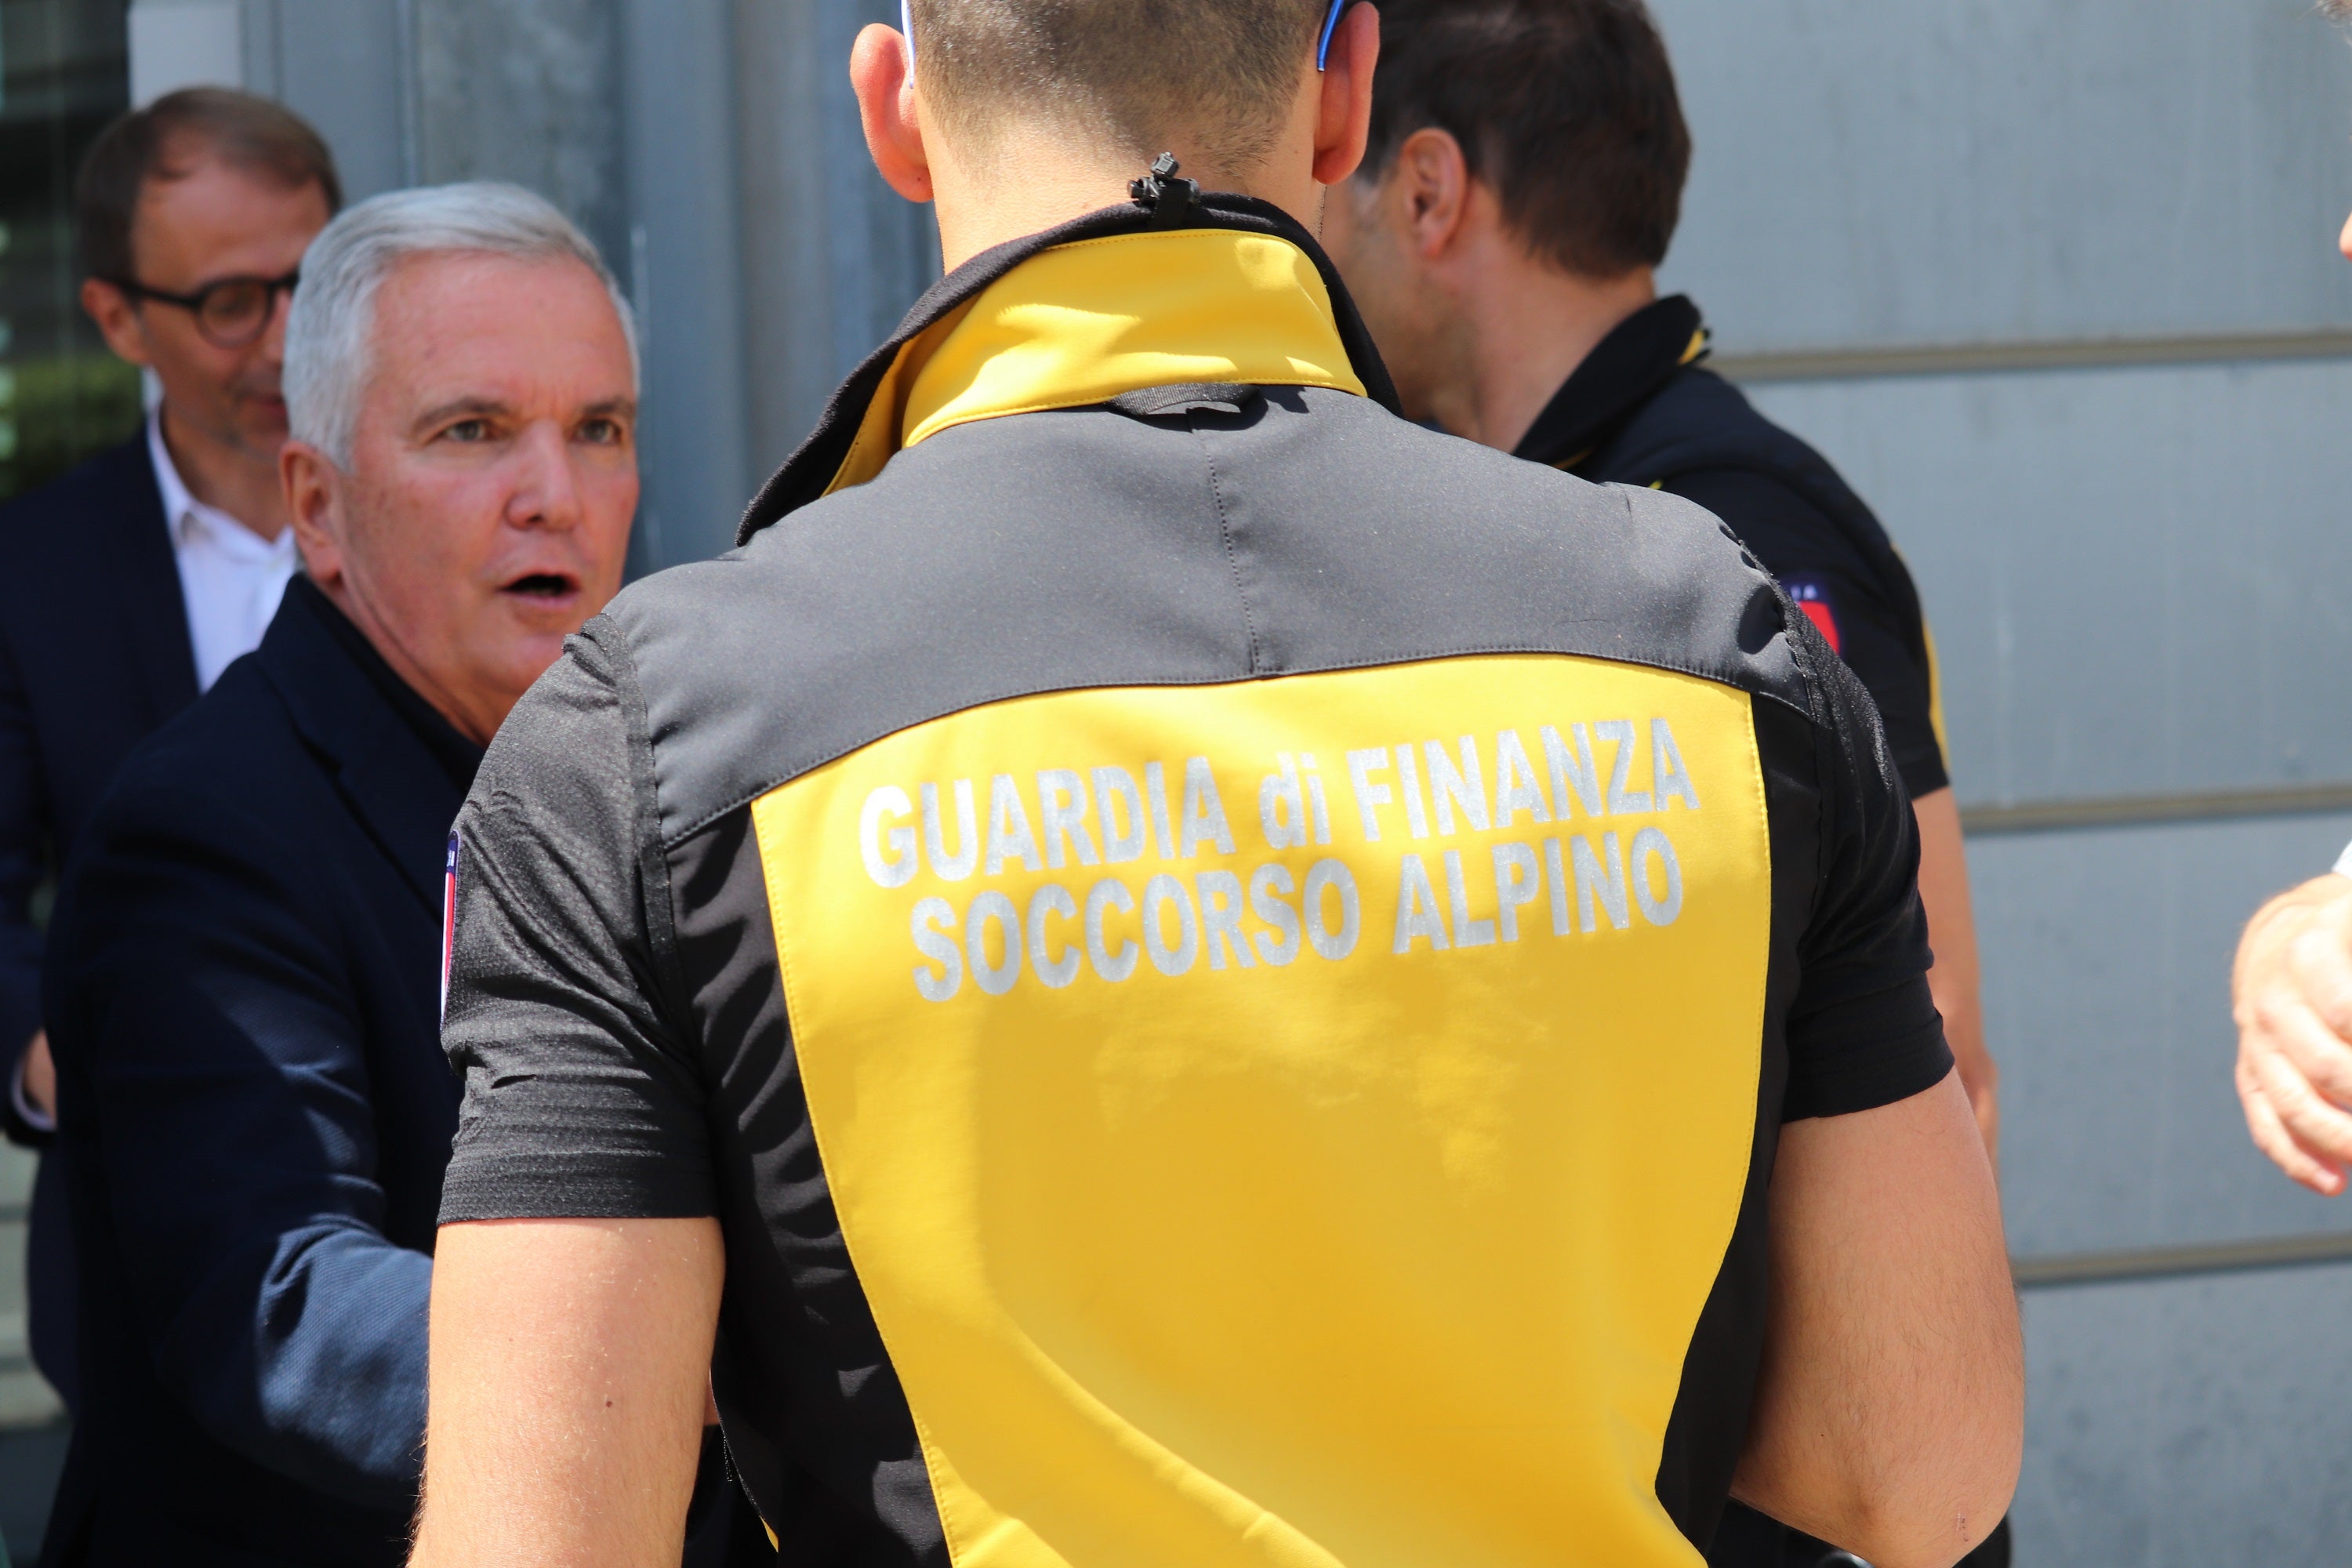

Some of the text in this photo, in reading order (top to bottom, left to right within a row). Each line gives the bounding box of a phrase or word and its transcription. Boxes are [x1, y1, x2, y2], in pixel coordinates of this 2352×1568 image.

[860, 718, 1699, 888] GUARDIA di FINANZA
[911, 826, 1683, 1002] SOCCORSO ALPINO
